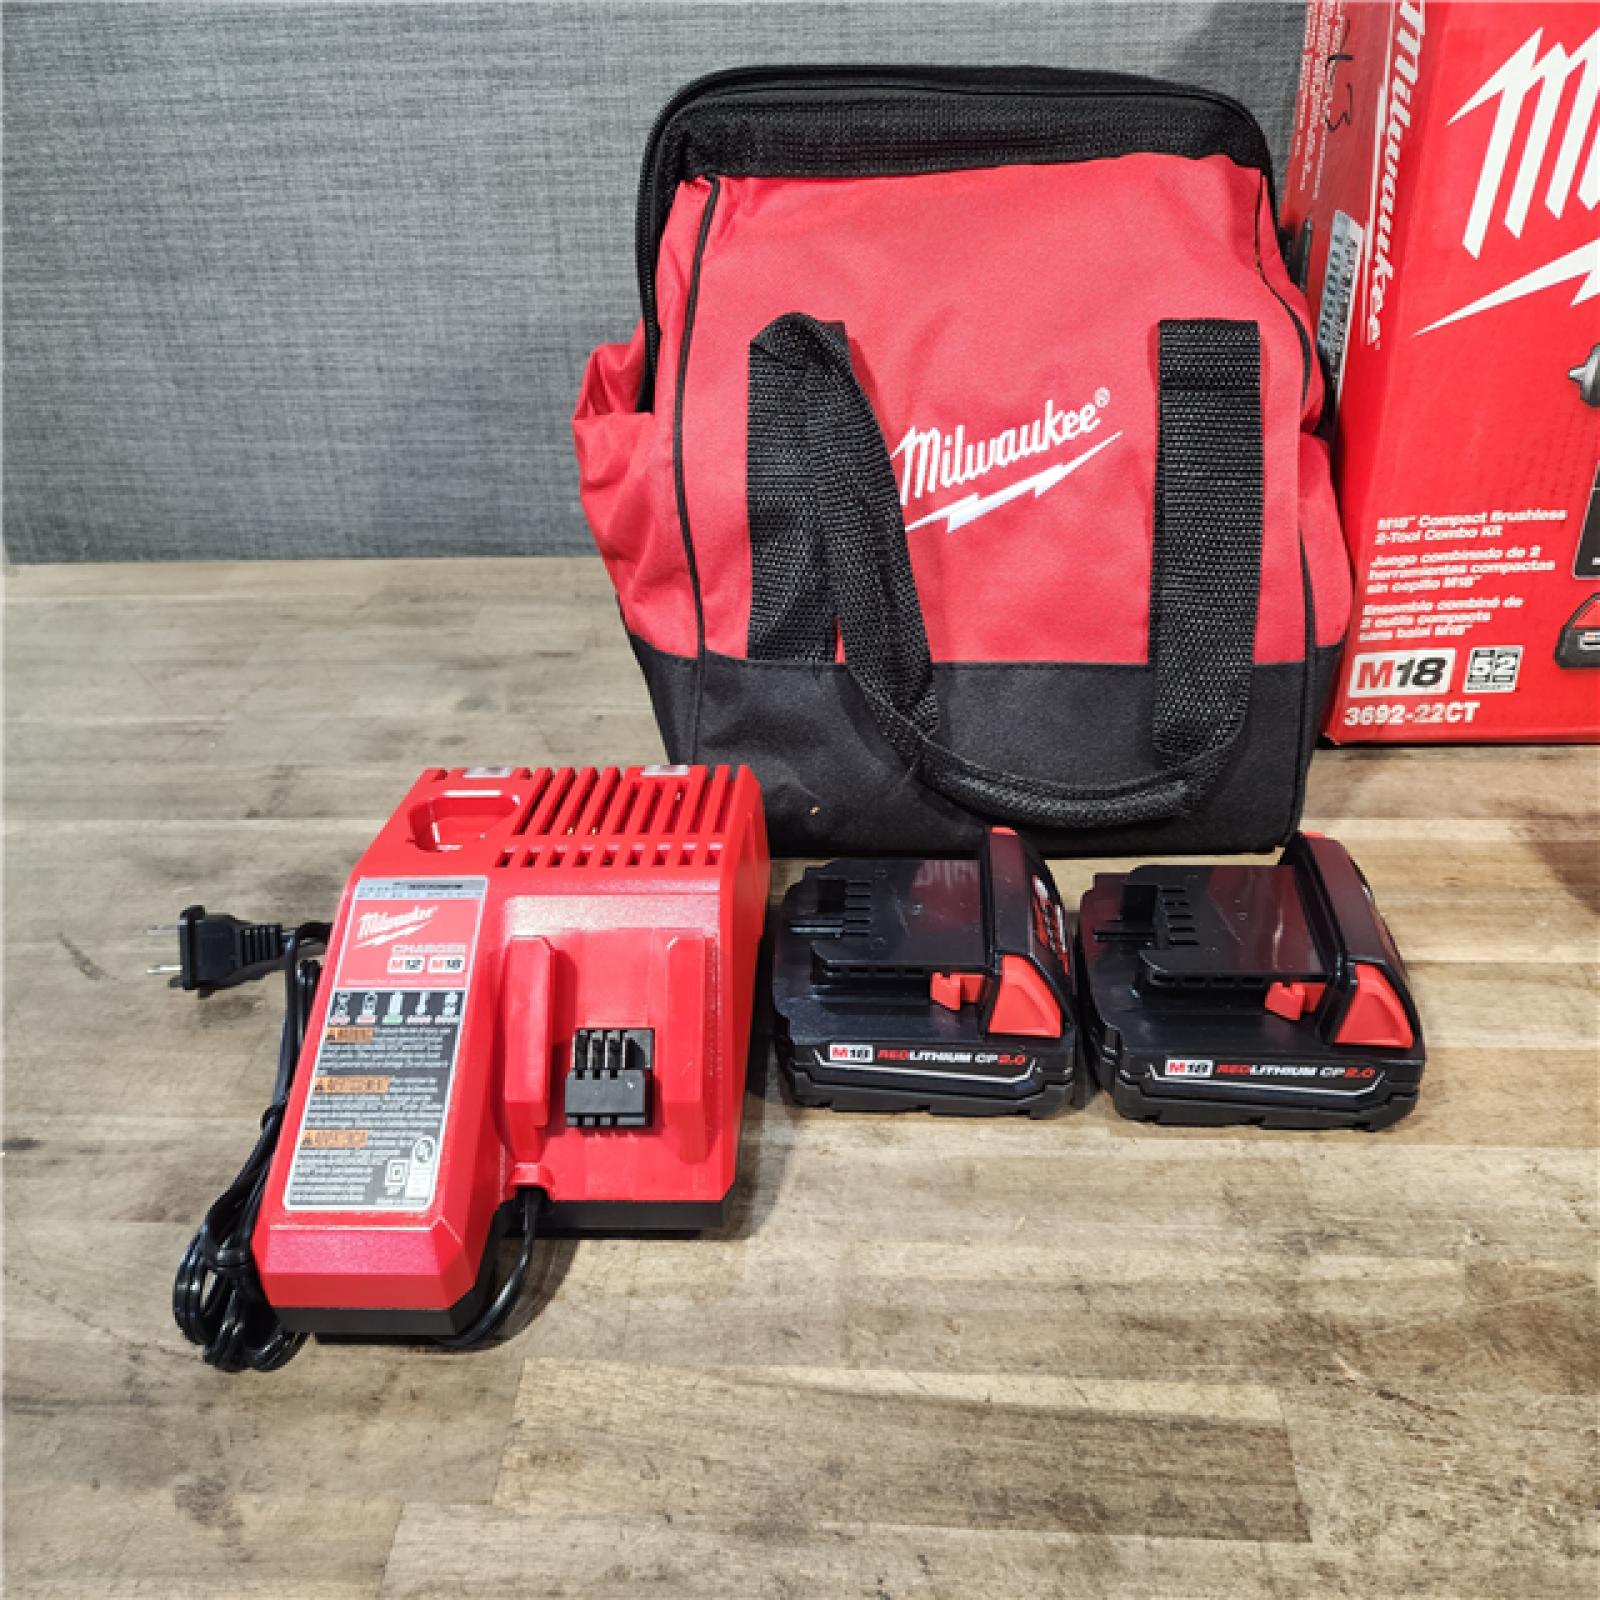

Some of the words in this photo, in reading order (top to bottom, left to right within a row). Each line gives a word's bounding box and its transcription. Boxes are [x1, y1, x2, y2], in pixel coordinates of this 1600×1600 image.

[1418, 512, 1487, 527] Compact
[1357, 657, 1447, 688] M18
[1344, 701, 1480, 725] 3692-22CT
